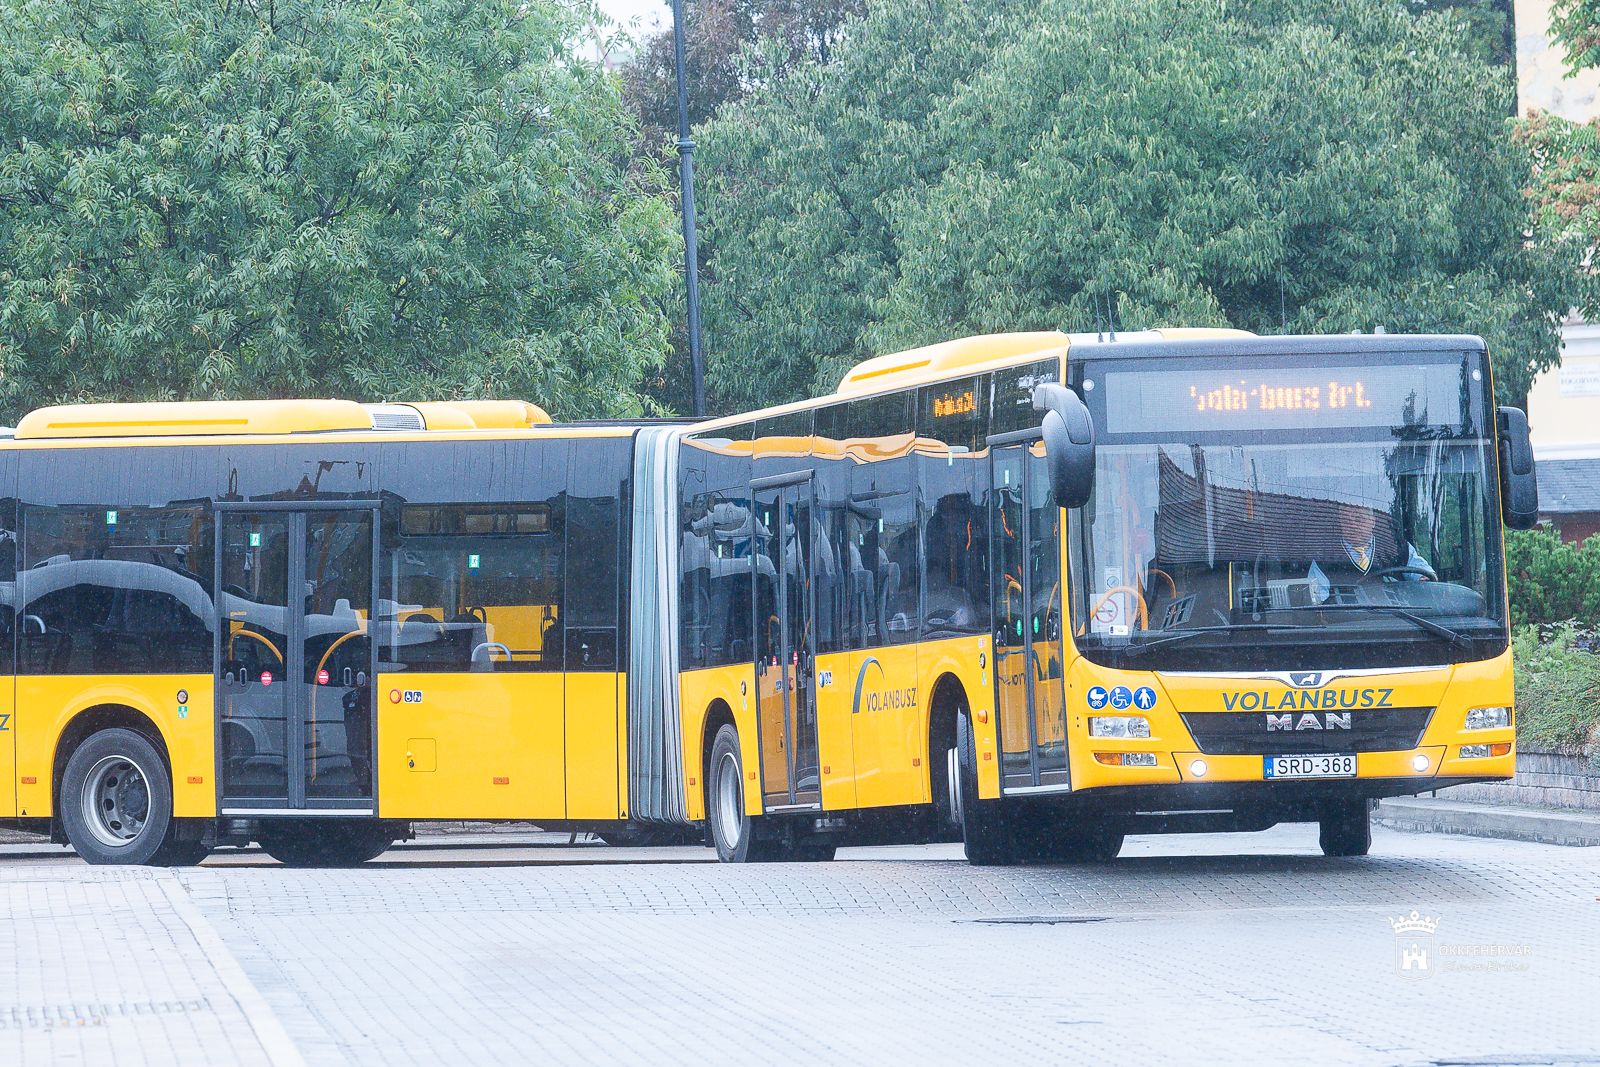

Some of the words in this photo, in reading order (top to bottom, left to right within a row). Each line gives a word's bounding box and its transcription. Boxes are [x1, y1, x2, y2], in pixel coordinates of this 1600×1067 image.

[1222, 688, 1394, 711] VOLÁNBUSZ
[1266, 712, 1352, 732] MAN
[1277, 757, 1352, 774] SRD-368
